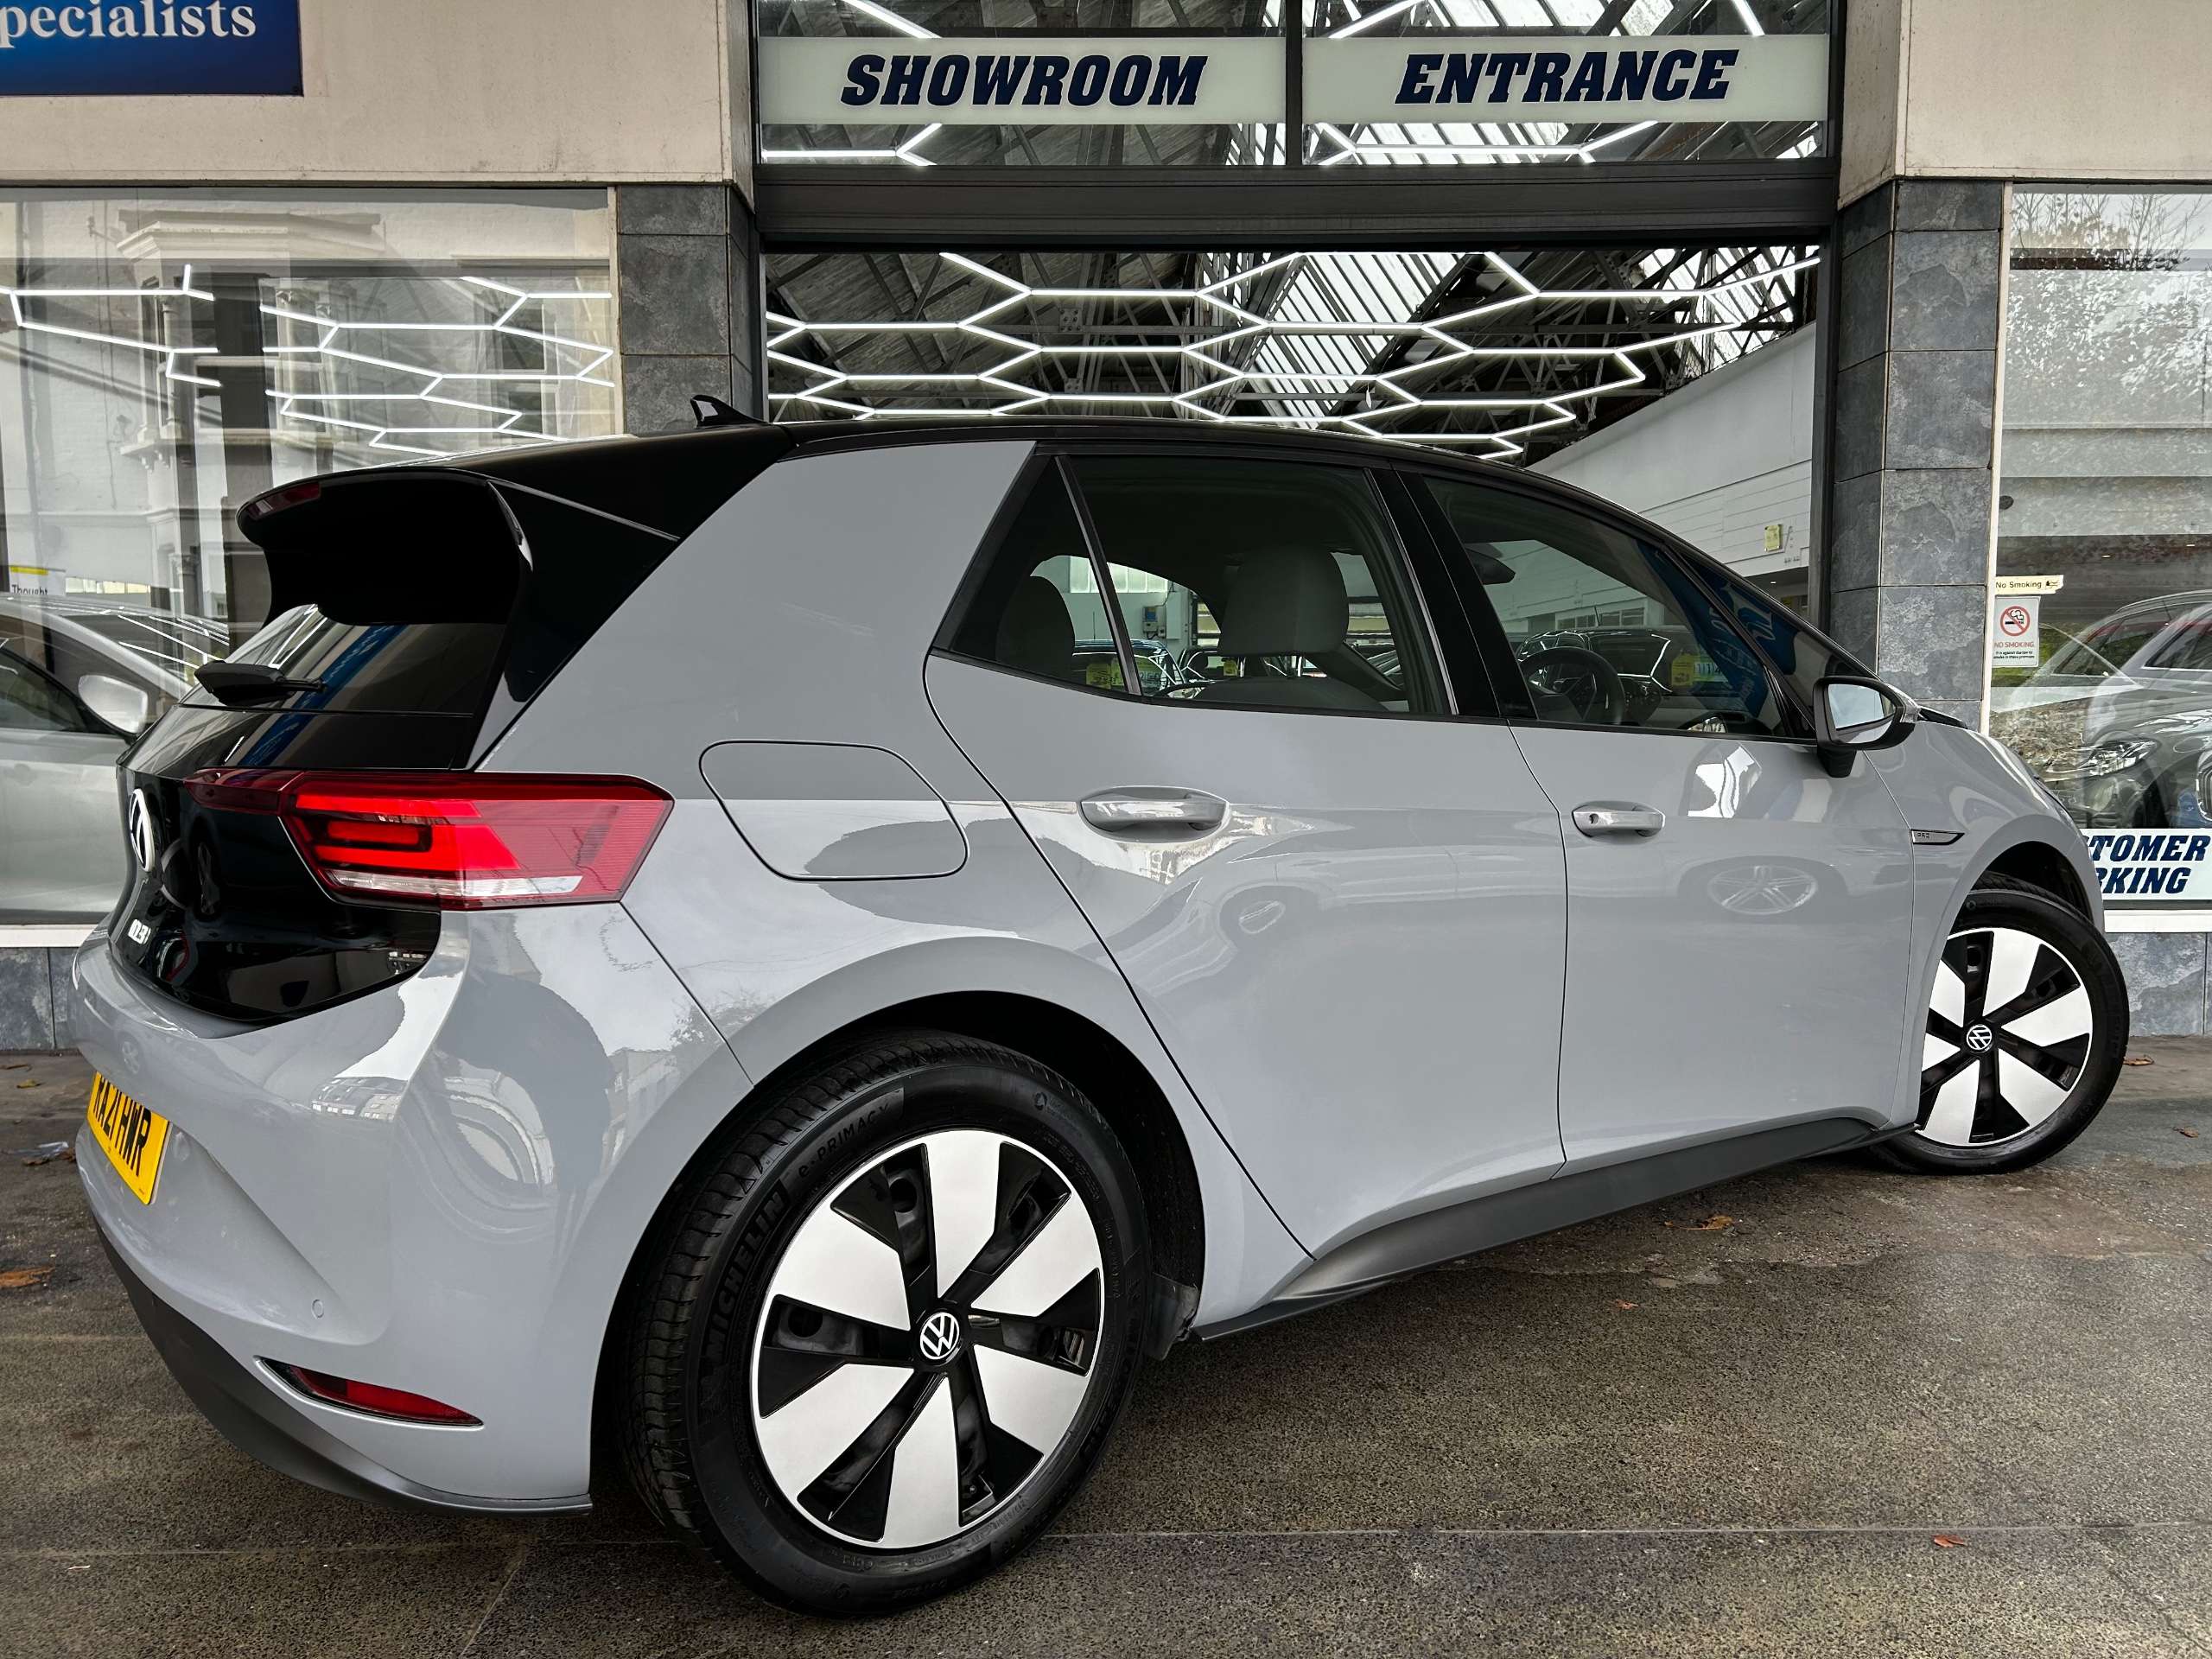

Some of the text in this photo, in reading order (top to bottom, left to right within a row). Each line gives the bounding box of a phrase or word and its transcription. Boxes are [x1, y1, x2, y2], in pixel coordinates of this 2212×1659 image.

[840, 48, 1740, 106] SHOWROOM ENTRANCE
[2083, 835, 2211, 862] TOMER
